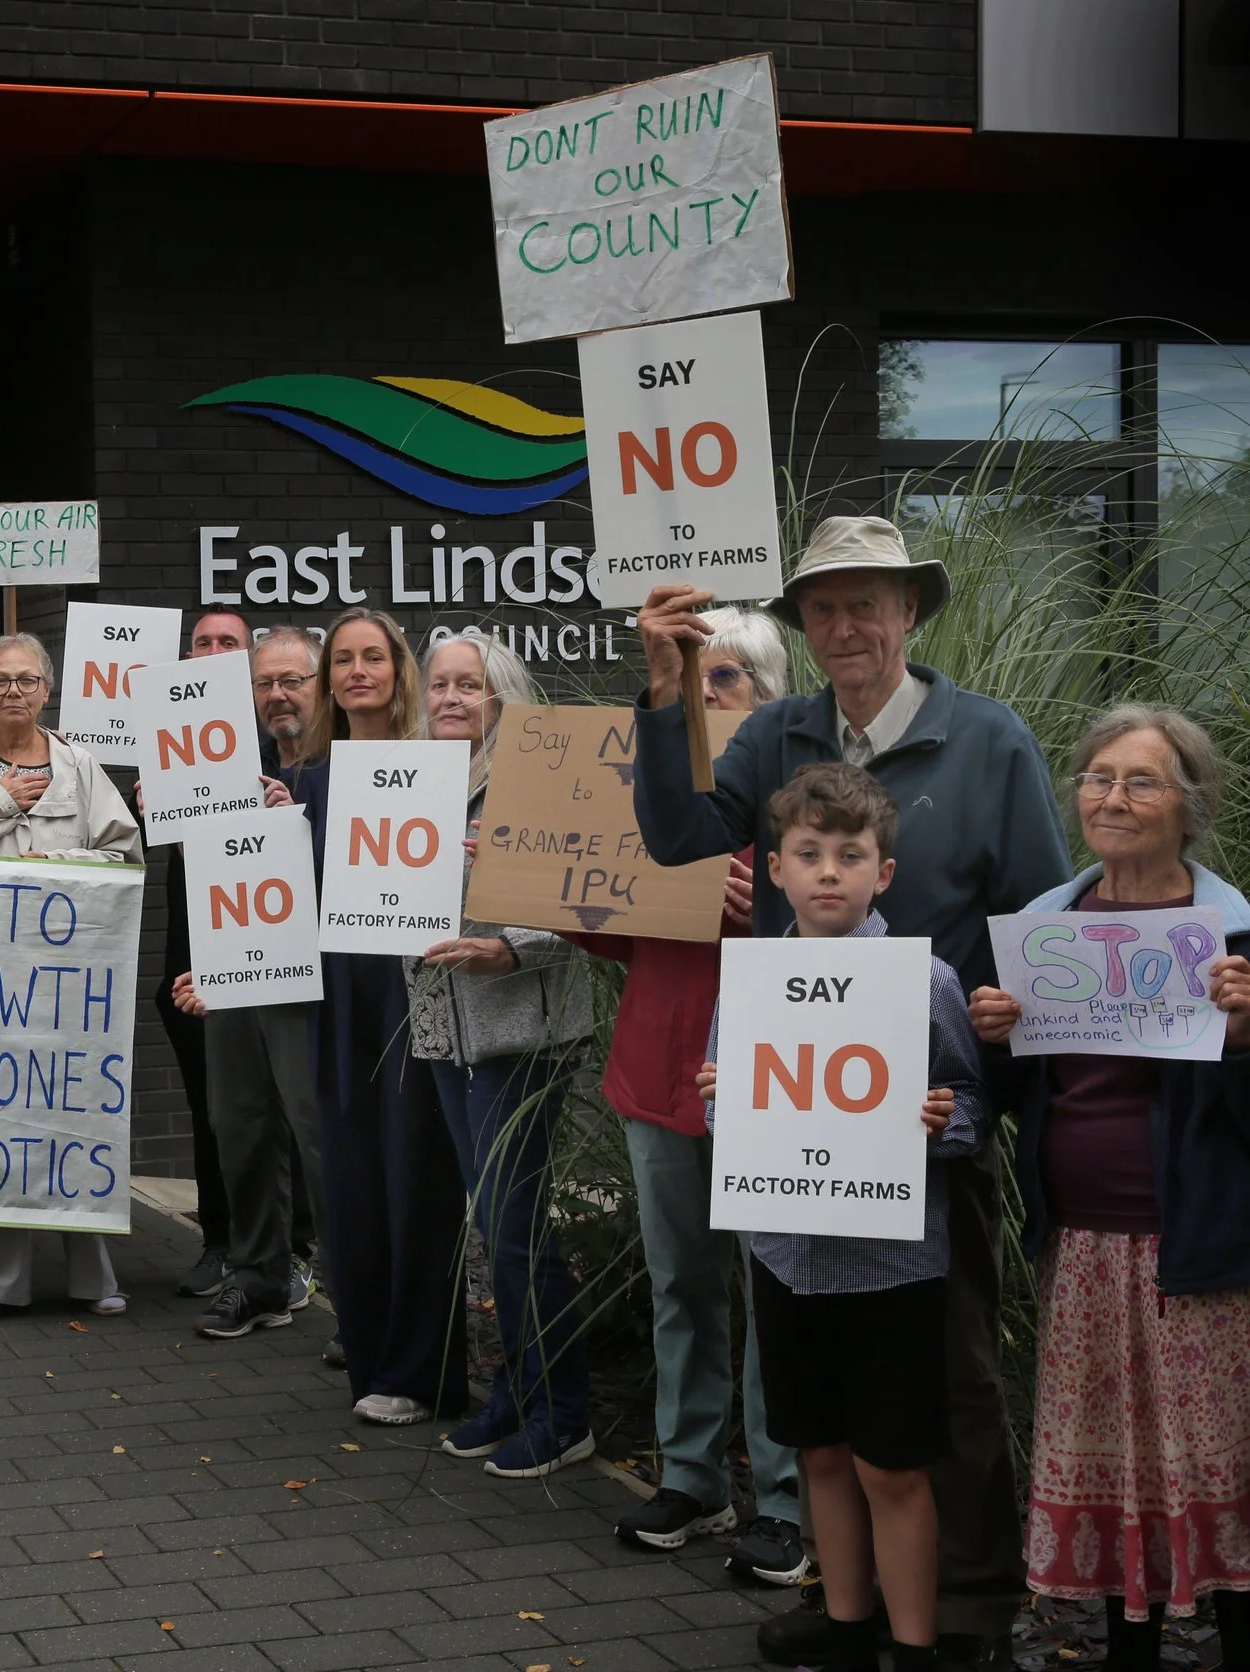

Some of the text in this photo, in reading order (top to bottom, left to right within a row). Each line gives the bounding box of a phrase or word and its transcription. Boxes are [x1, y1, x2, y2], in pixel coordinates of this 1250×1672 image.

[506, 89, 724, 173] DONT RUIN
[595, 153, 680, 197] OUR
[518, 188, 759, 274] COUNTY
[637, 359, 696, 389] SAY
[617, 420, 738, 496] NO
[0, 508, 49, 532] OUR
[57, 503, 97, 530] AIR
[669, 524, 696, 541] TO
[199, 526, 367, 605] East
[607, 546, 768, 574] FACTORY FARMS
[103, 626, 140, 641] SAY
[83, 661, 148, 699] N
[169, 681, 207, 702] SAY
[109, 719, 125, 729] TO
[66, 732, 122, 745] FACTORY
[156, 719, 237, 770] NO
[518, 716, 636, 770] Say N
[372, 769, 418, 788] SAY
[572, 777, 593, 800] to
[193, 786, 211, 798] TO
[151, 797, 258, 823] FACTORY FARMS
[225, 836, 266, 856] SAY
[348, 817, 440, 868] NO
[491, 825, 603, 861] GRANGE
[560, 867, 638, 905] IPU
[209, 877, 294, 930] NO
[380, 894, 399, 905] TO
[328, 913, 450, 930] FACTORY FARMS
[245, 950, 264, 962] TO
[199, 965, 314, 986] FACTORY FARMS
[785, 977, 853, 1003] SAY
[1020, 1012, 1123, 1026] unkind and
[1024, 1029, 1123, 1041] uneconomic
[752, 1043, 889, 1113] NO
[801, 1148, 831, 1166] TO
[724, 1175, 911, 1201] FACTORY FARMS
